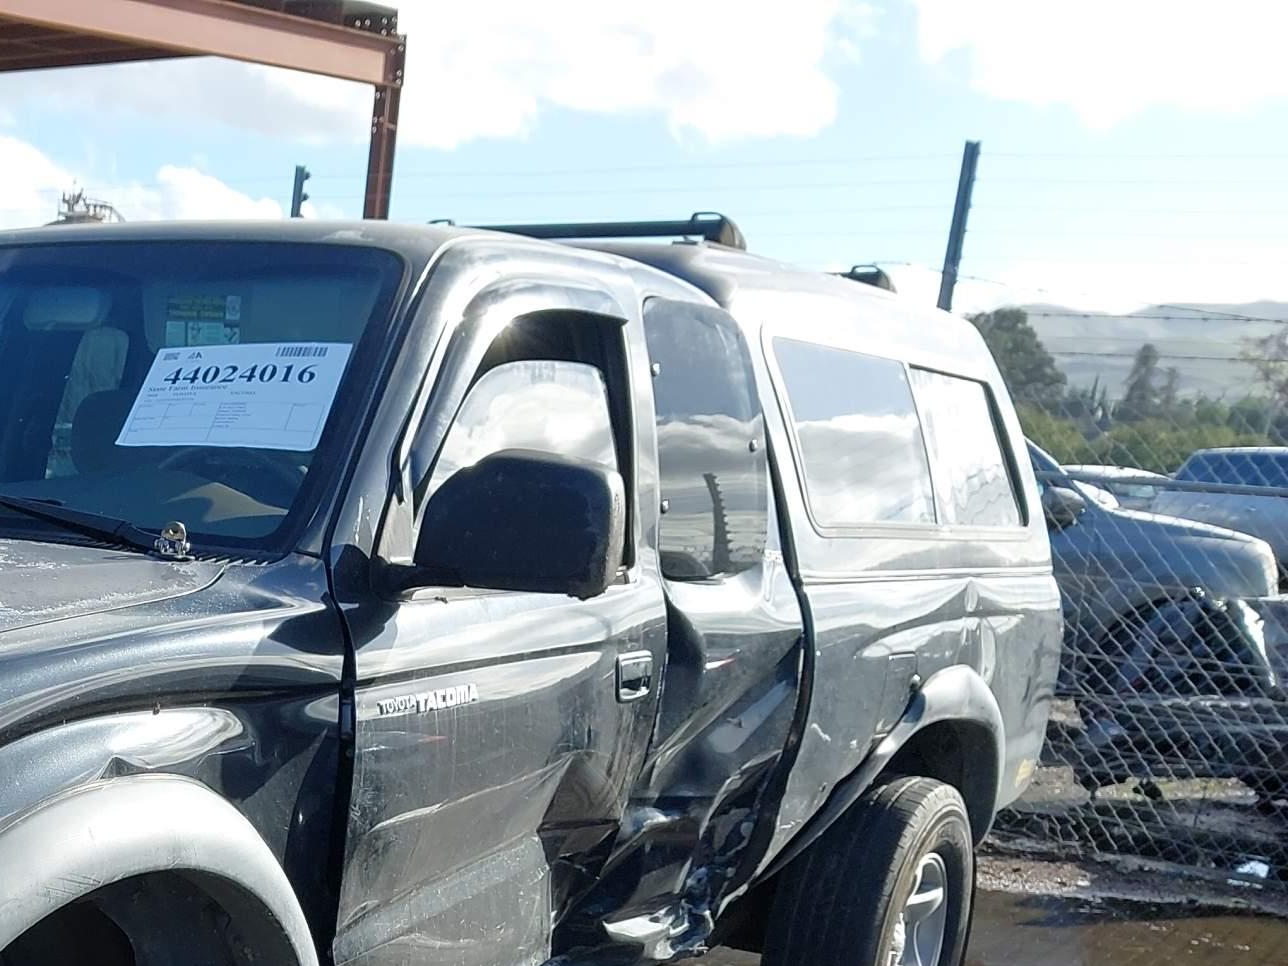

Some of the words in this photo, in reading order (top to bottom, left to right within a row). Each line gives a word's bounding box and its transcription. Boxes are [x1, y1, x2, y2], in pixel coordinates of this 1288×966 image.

[164, 363, 319, 385] 44024016
[377, 695, 416, 715] TOYOTA
[416, 684, 479, 713] TACOMA
